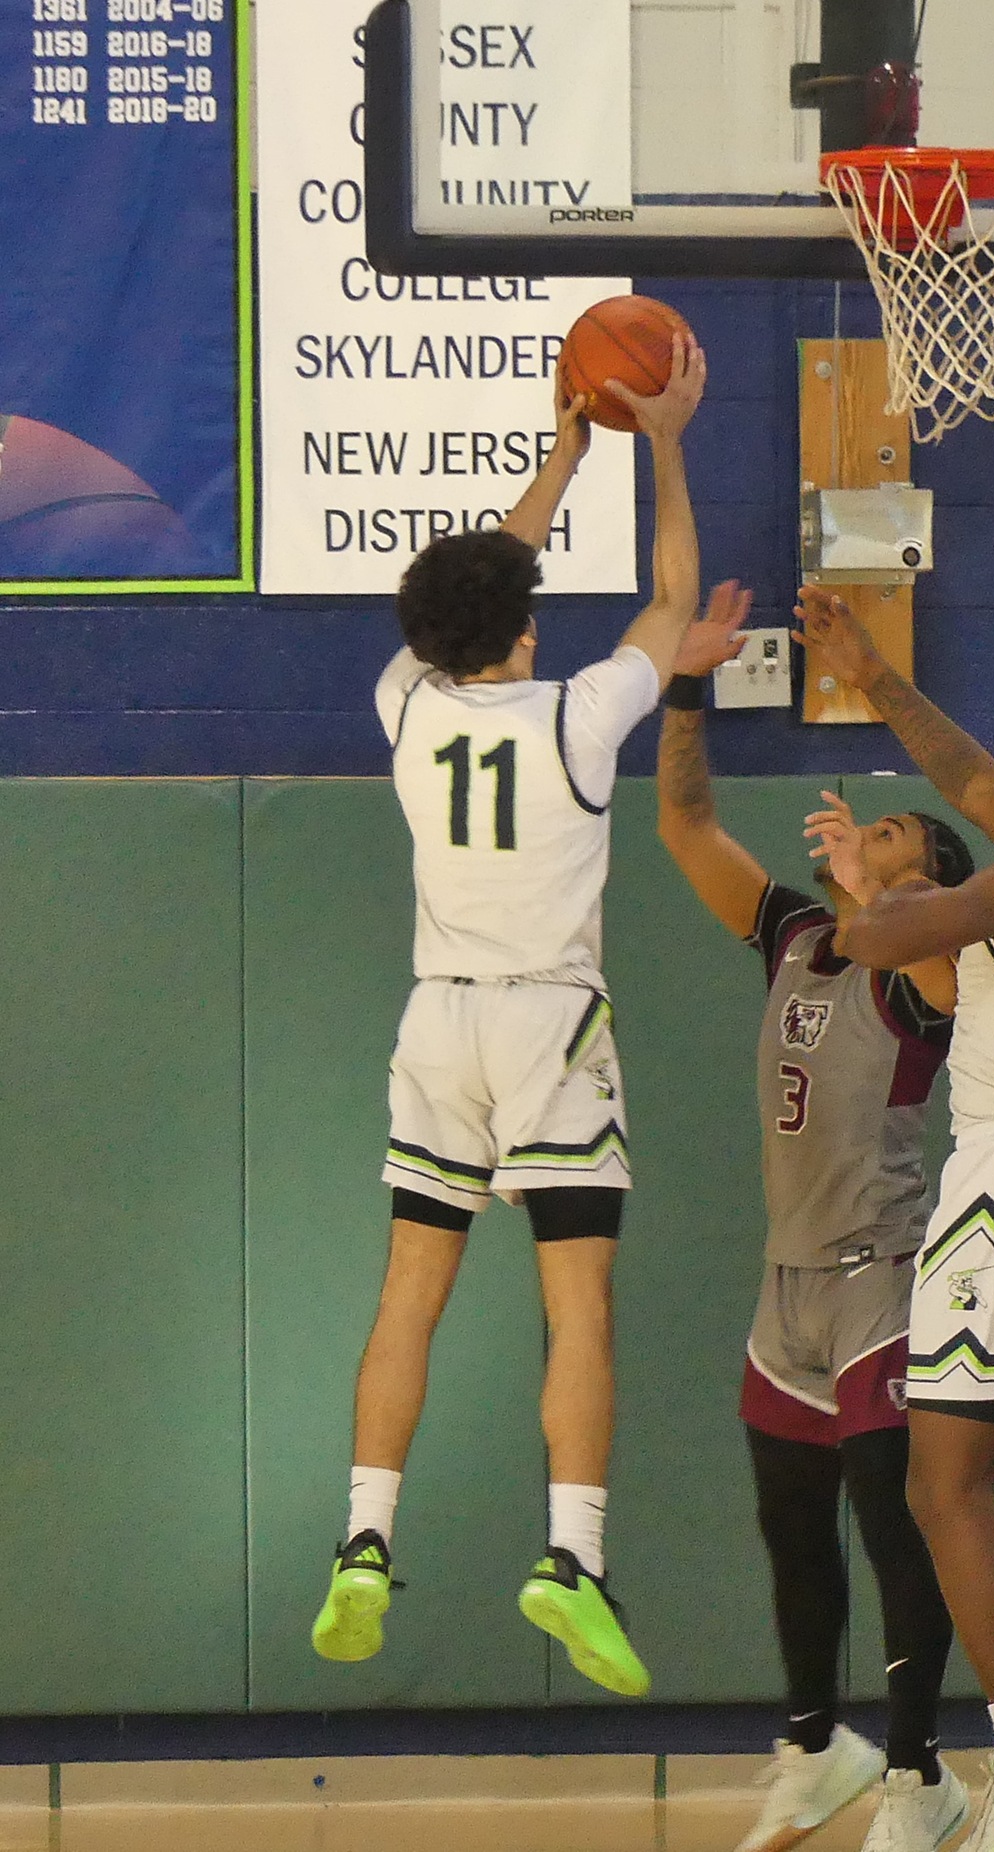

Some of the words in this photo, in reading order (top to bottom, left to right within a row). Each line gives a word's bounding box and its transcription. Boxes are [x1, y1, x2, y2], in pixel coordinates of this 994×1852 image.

[33, 0, 88, 21] 1361
[107, 0, 224, 22] 2004-06
[33, 30, 88, 57] 1159
[107, 30, 212, 57] 2016-18
[352, 25, 536, 69] SEX
[33, 65, 88, 93] 1180
[107, 65, 212, 93] 2015-18
[33, 97, 87, 124] 1241
[107, 96, 217, 124] 2018-20
[304, 431, 408, 475] NEW
[419, 431, 578, 475] JERSE
[325, 509, 515, 552] DISTRI
[544, 509, 571, 552] H
[434, 734, 517, 850] 11
[776, 1061, 813, 1136] 3
